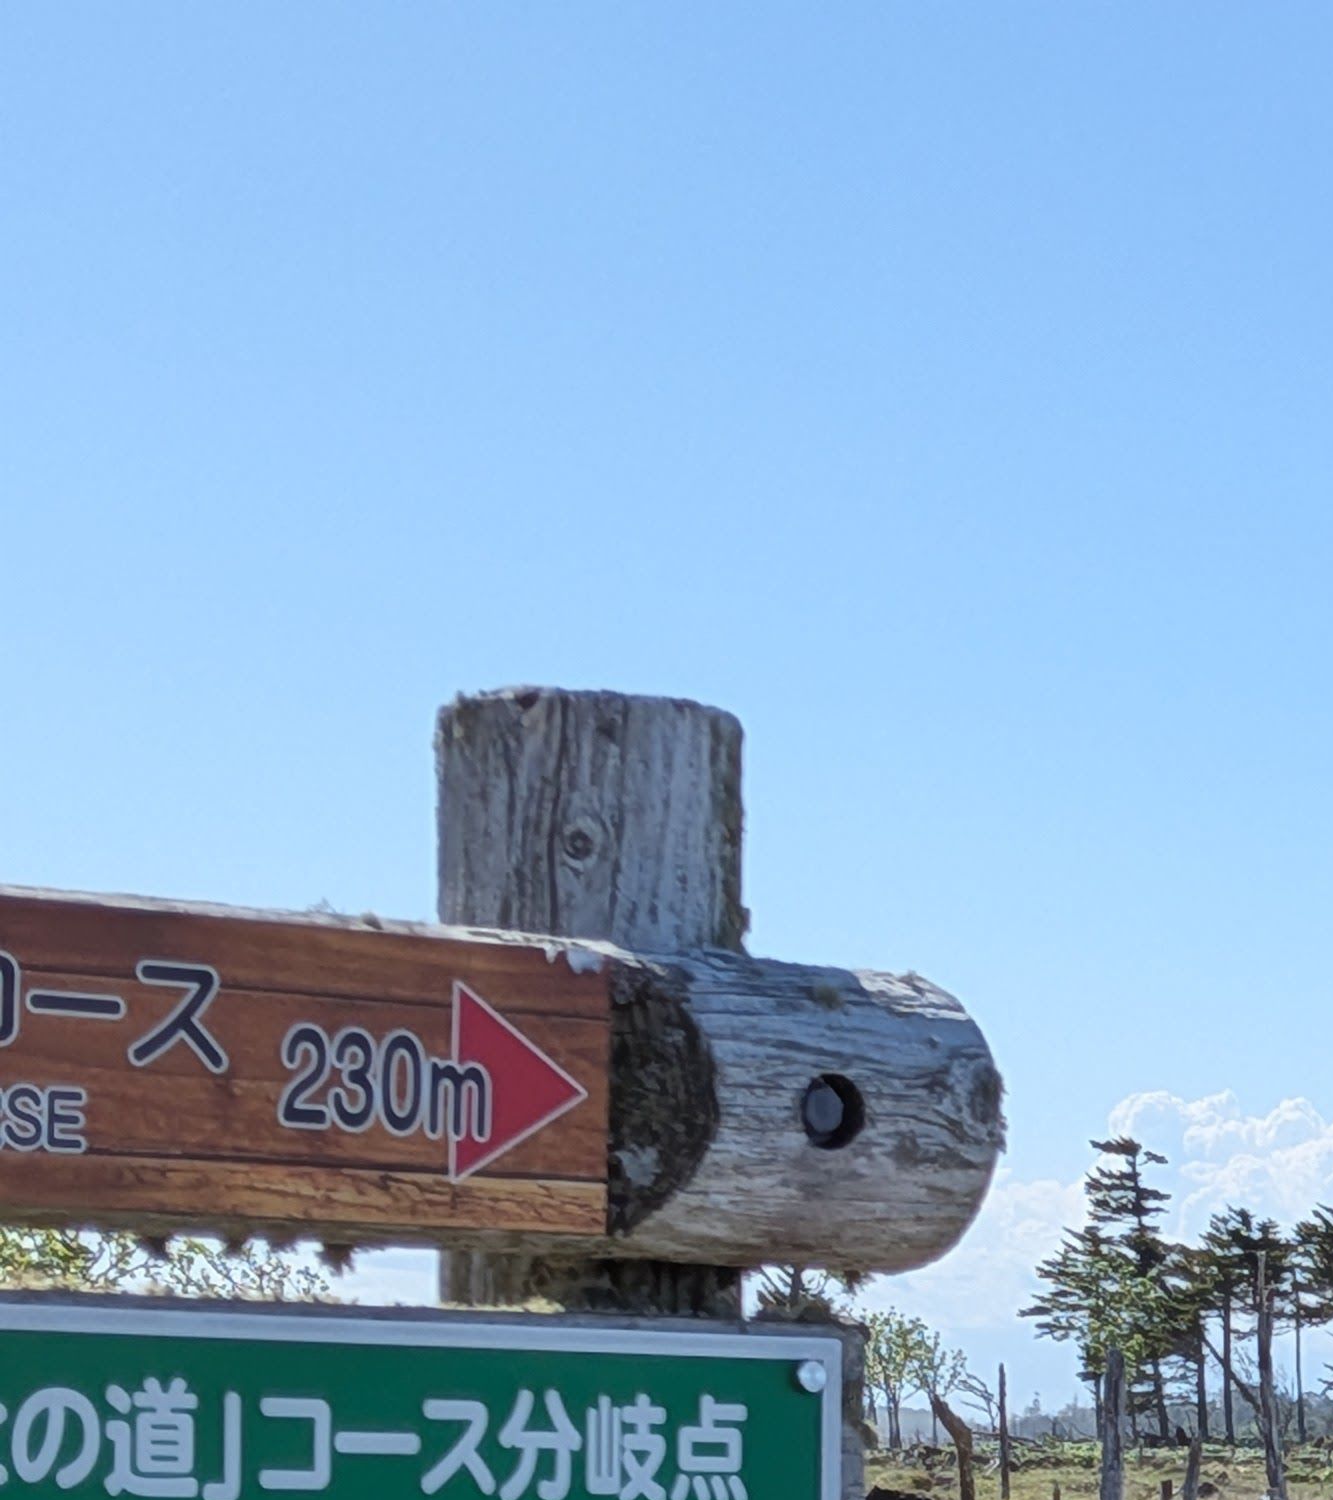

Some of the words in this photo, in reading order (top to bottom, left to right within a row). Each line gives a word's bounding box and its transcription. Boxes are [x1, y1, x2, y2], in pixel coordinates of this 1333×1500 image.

[0, 950, 228, 1074] ース
[0, 1081, 88, 1152] SE
[278, 1022, 492, 1143] 230m
